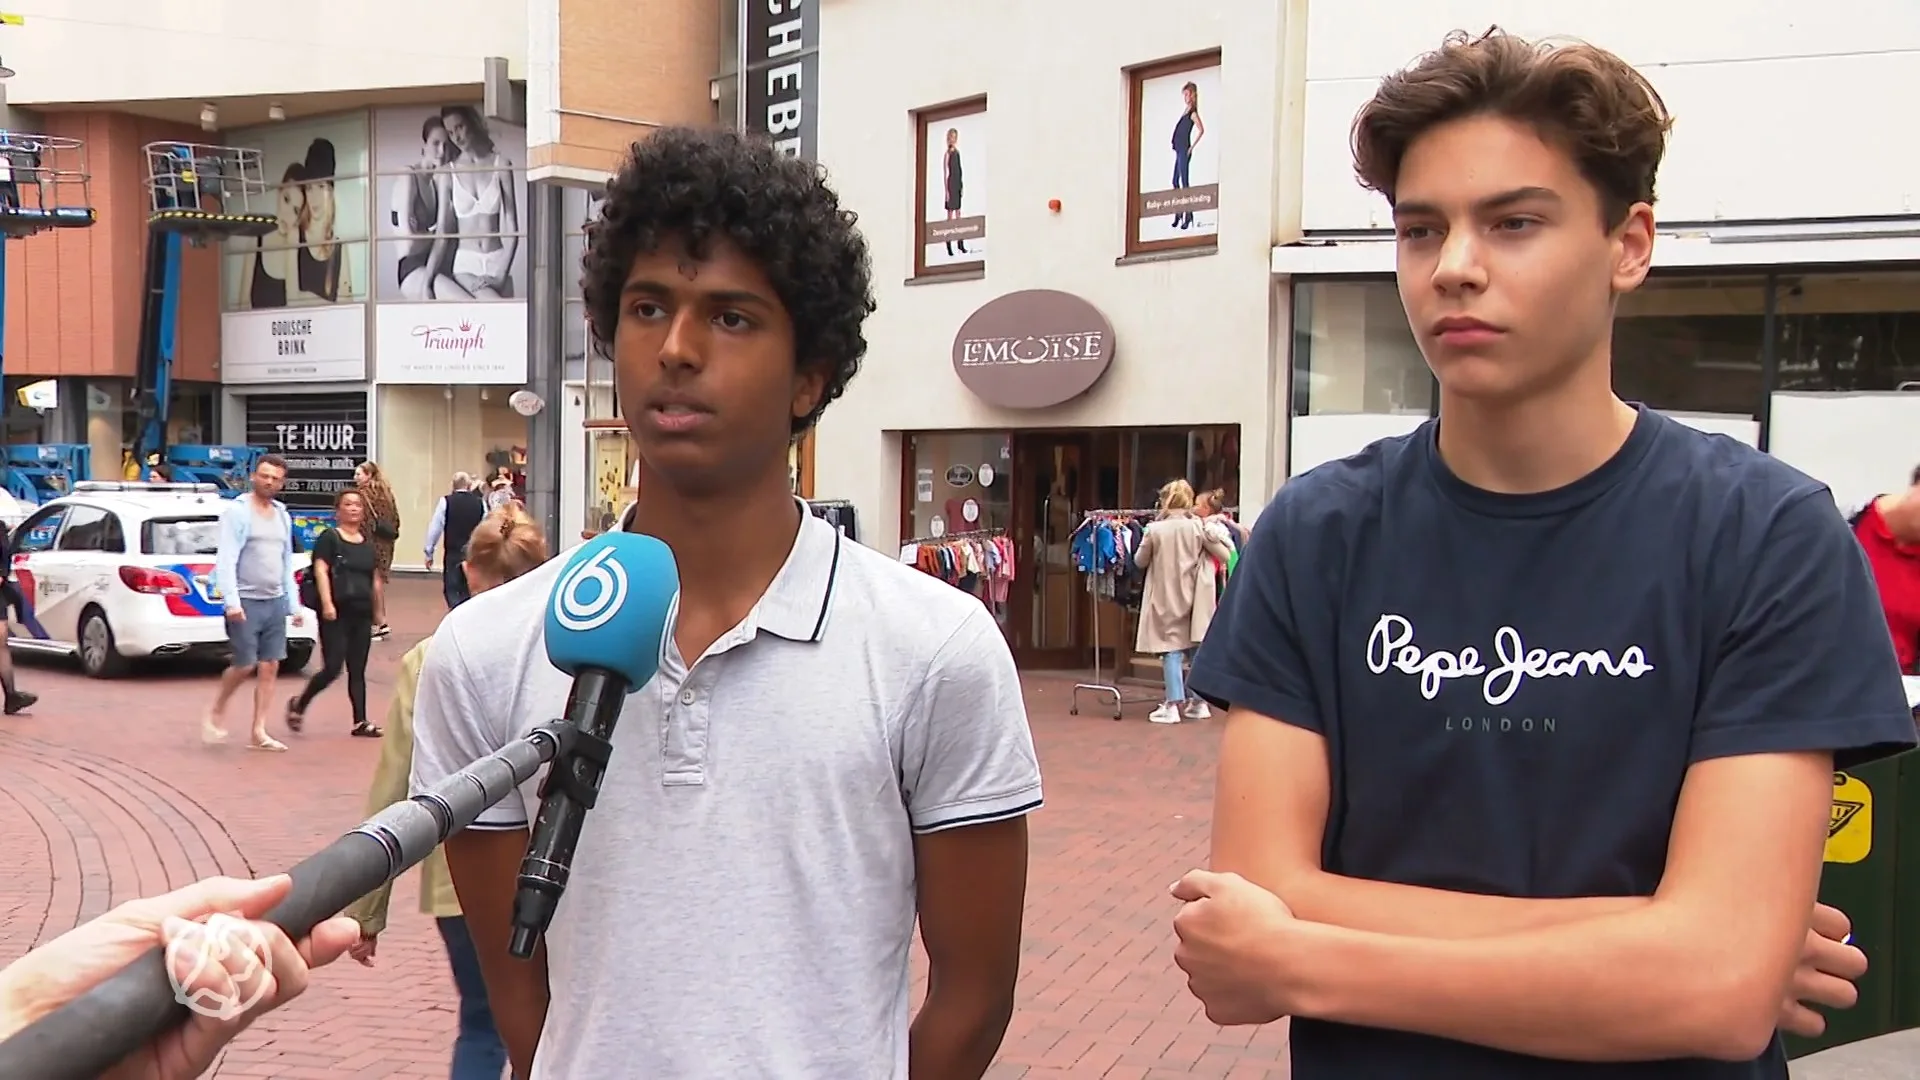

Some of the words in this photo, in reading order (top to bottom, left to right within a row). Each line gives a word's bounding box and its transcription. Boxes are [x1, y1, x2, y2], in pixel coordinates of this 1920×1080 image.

[278, 339, 306, 355] BRINK
[411, 324, 486, 358] Triumph
[276, 424, 298, 450] TE
[303, 424, 354, 450] HUUR
[1367, 614, 1486, 700] Pepe
[1483, 626, 1654, 705] Jeans
[1445, 717, 1556, 732] LONDON
